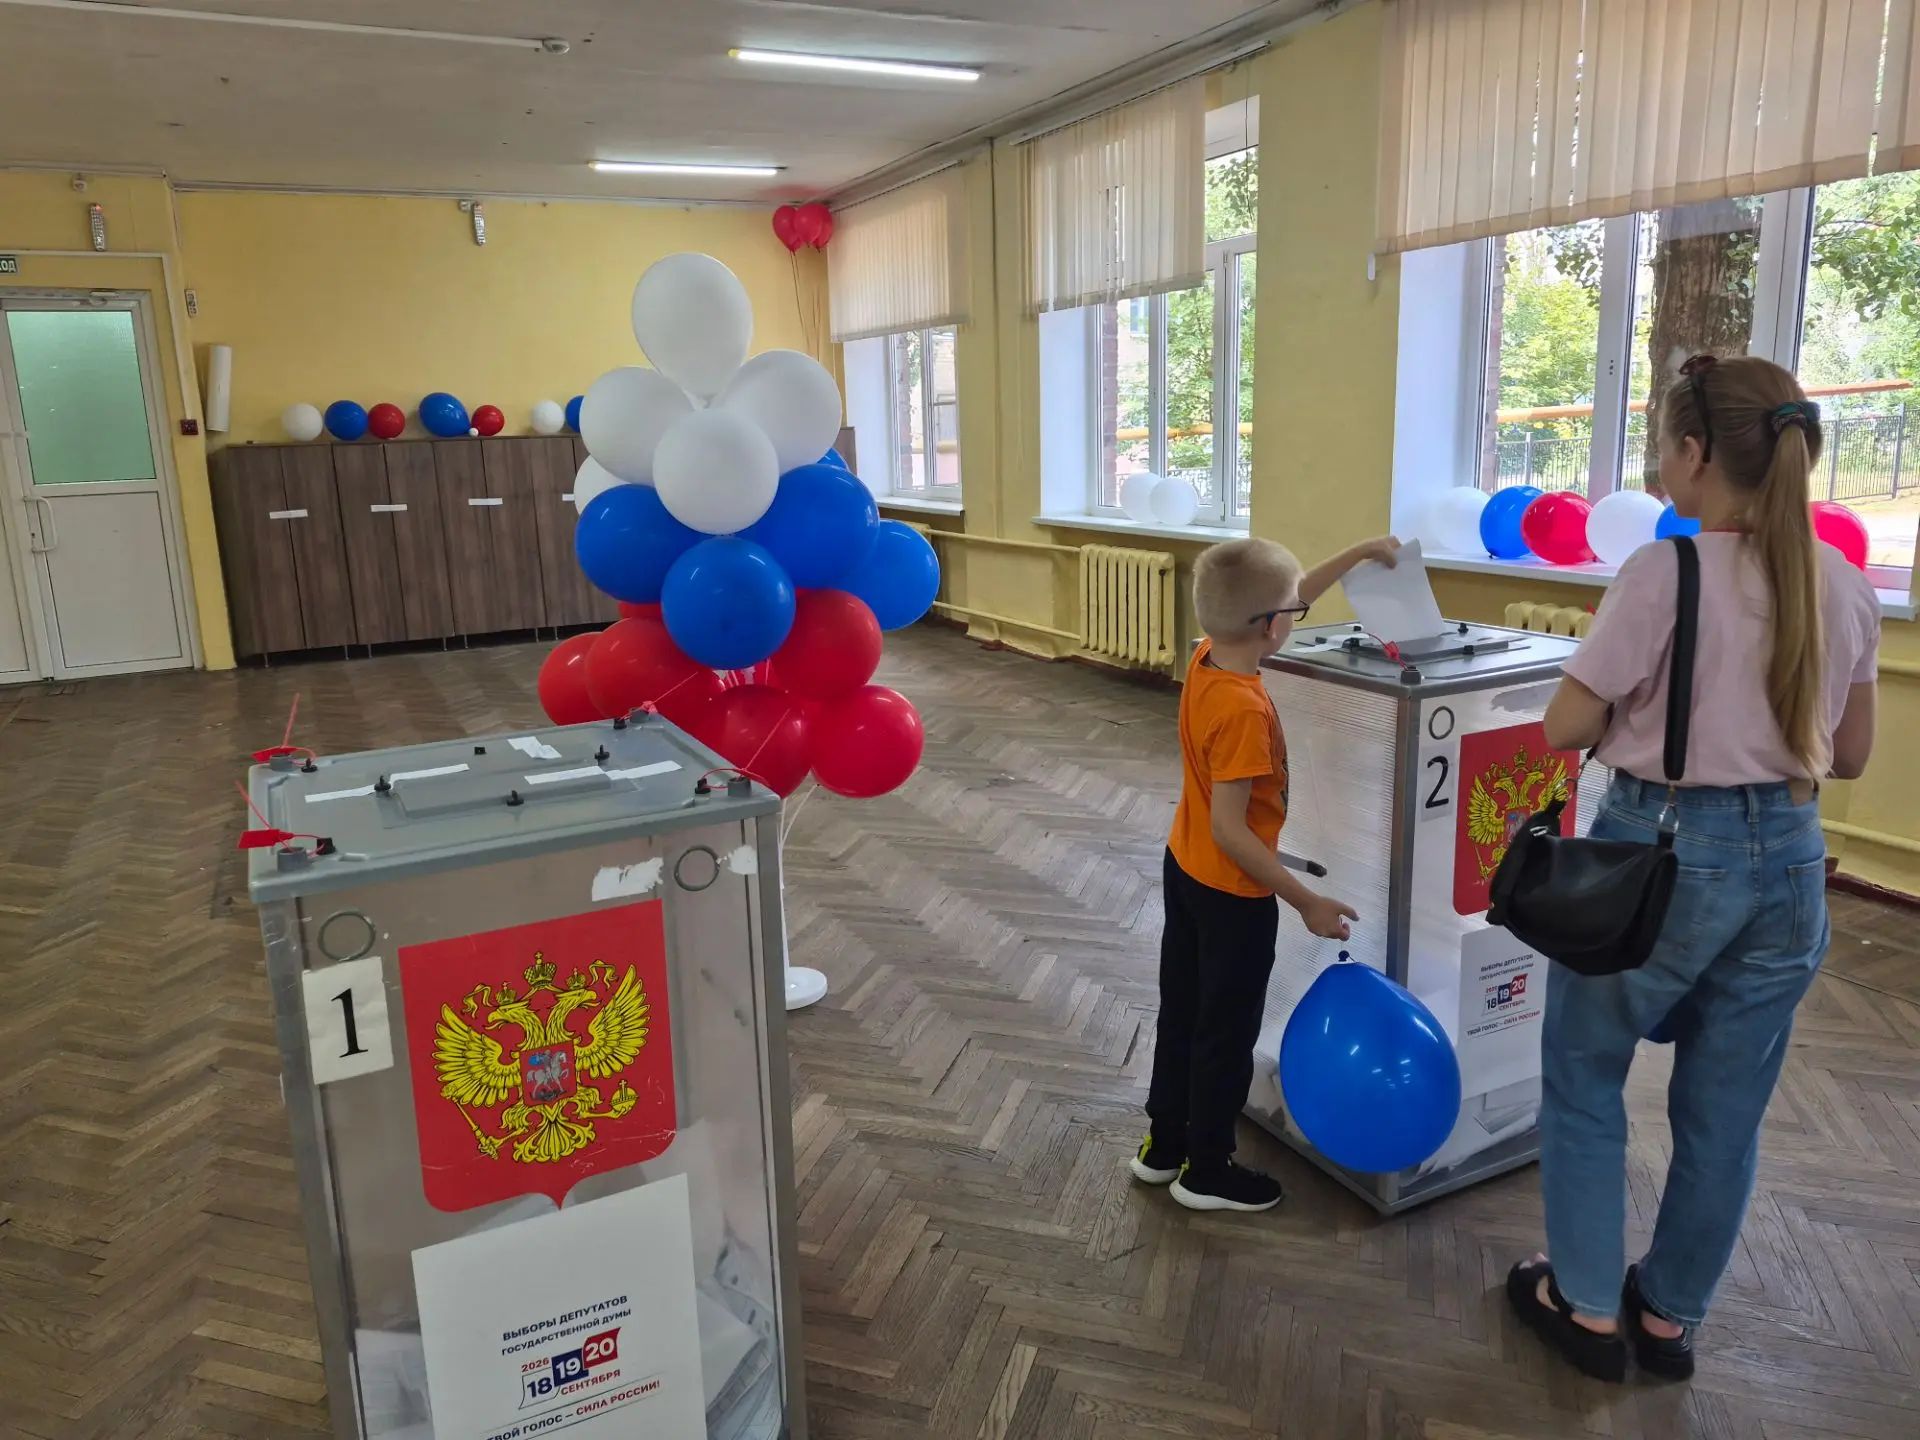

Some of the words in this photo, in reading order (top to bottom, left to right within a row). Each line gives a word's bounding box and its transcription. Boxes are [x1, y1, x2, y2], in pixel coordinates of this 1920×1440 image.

[0, 260, 16, 272] ОД
[1425, 755, 1449, 809] 2
[1487, 998, 1497, 1010] 18
[1498, 988, 1510, 1000] 19
[1511, 978, 1525, 992] 20
[331, 987, 368, 1058] 1
[502, 1318, 600, 1356] ГОСУДАРСТВЕННОЙ
[601, 1309, 631, 1325] ДУМЫ
[503, 1318, 557, 1341] ВЫБОРЫ
[559, 1295, 628, 1325] ДЕПУТАТОВ
[521, 1357, 550, 1373] 2026
[526, 1377, 553, 1398] 18
[555, 1357, 581, 1379] 19
[585, 1337, 615, 1362] 20
[561, 1369, 621, 1395] СЕНТЯБРЯ
[523, 1415, 563, 1434] ГОЛОС
[576, 1400, 608, 1416] СИЛА
[610, 1380, 660, 1404] РОССИИ!
